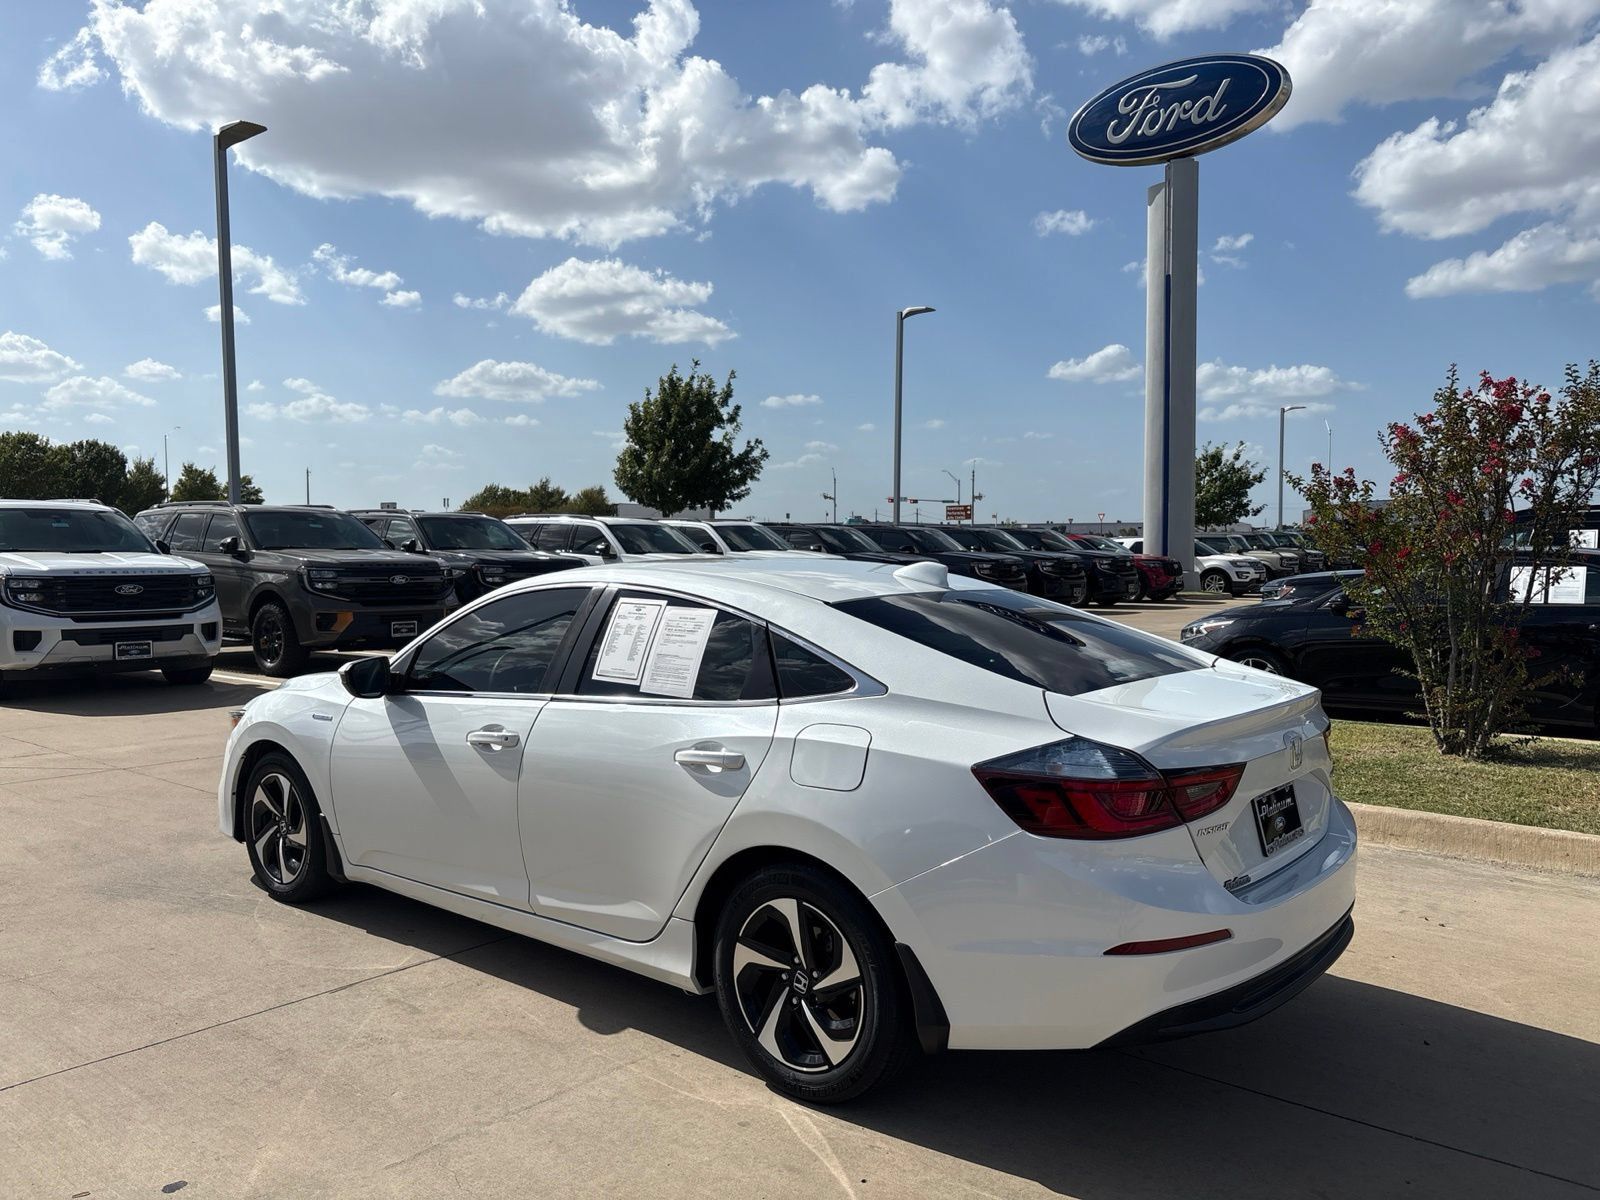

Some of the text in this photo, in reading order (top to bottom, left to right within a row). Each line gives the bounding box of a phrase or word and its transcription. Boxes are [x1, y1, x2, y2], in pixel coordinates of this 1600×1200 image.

[1106, 74, 1231, 144] Ford
[119, 584, 140, 594] Ford
[1197, 822, 1231, 837] INSIGHT
